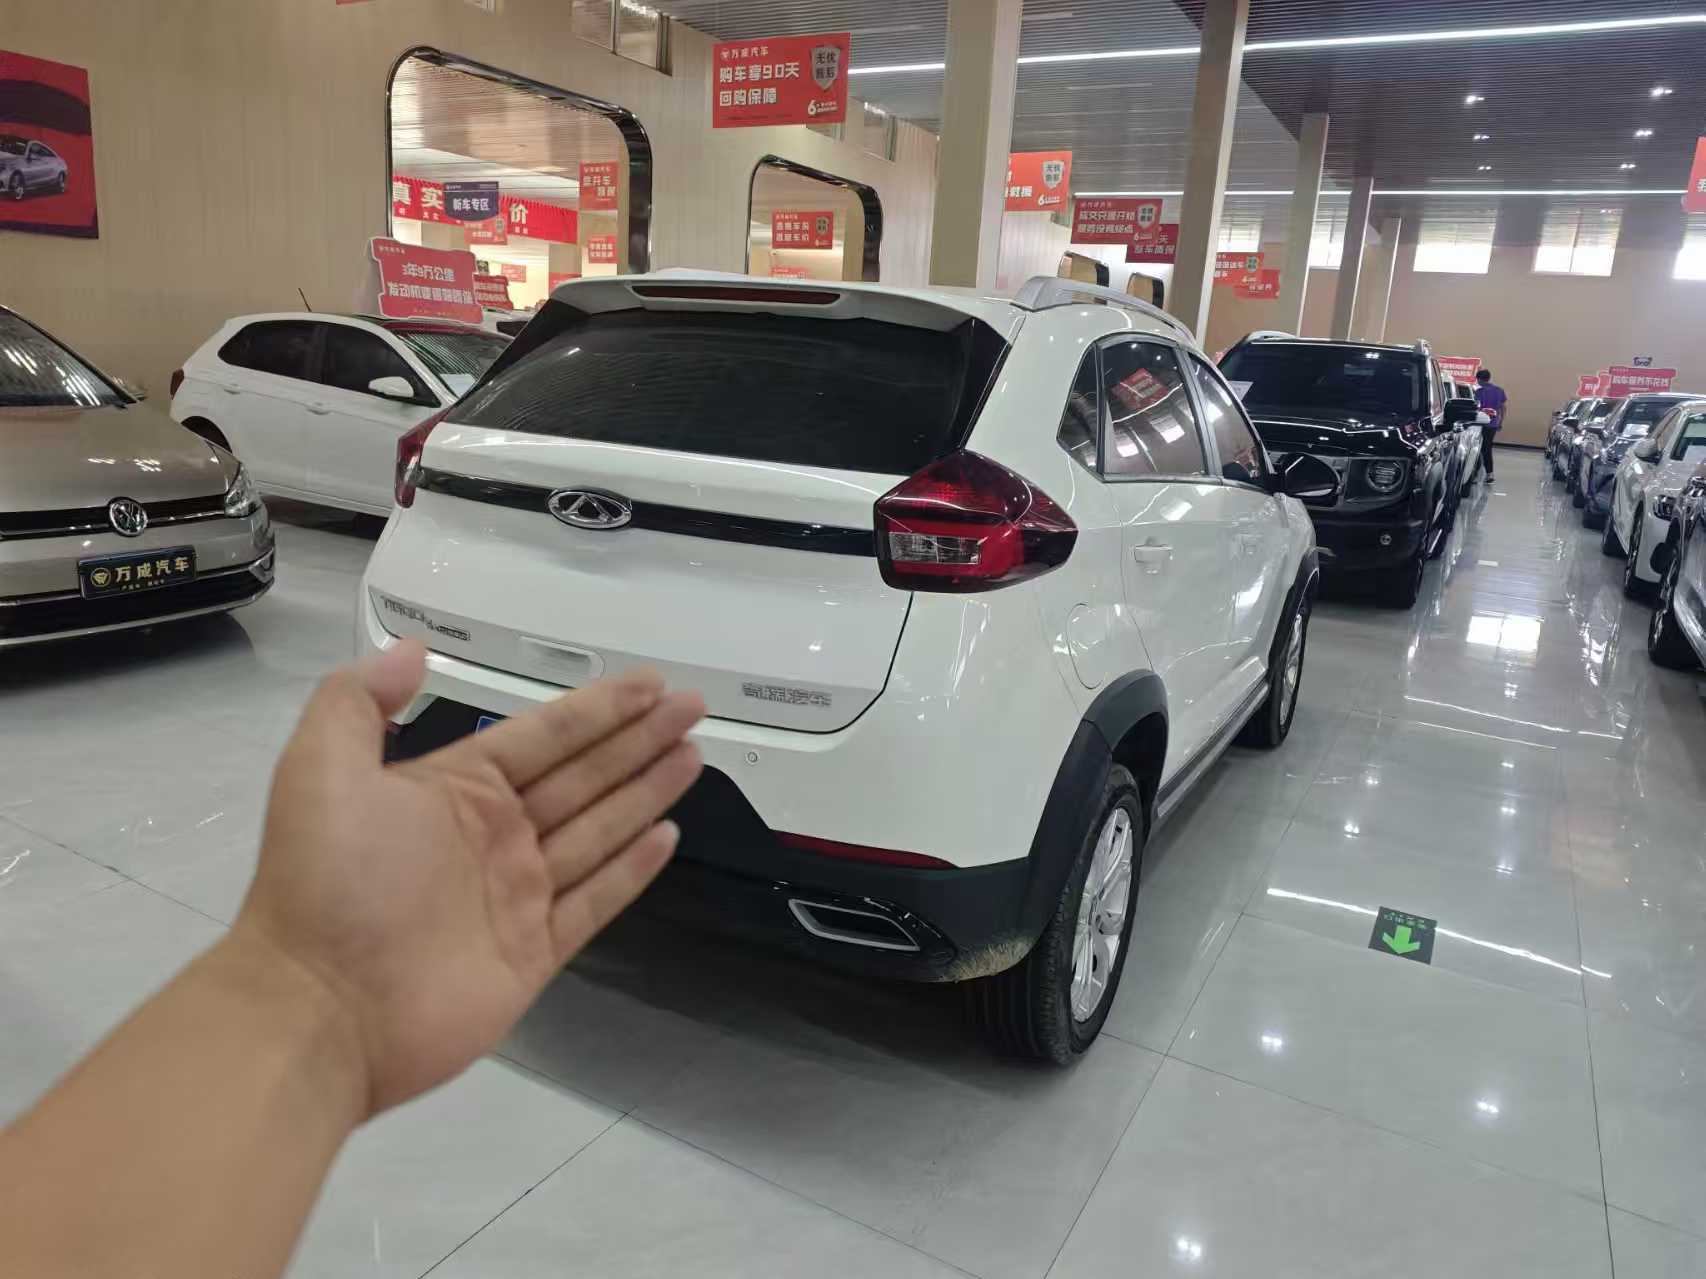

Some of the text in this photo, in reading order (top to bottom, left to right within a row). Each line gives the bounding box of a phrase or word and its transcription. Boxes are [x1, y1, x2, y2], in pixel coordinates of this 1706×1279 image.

[719, 62, 800, 83] 购车享90天
[719, 87, 777, 107] 回购保障
[453, 197, 490, 212] 新车专区
[114, 556, 190, 583] 万成汽车
